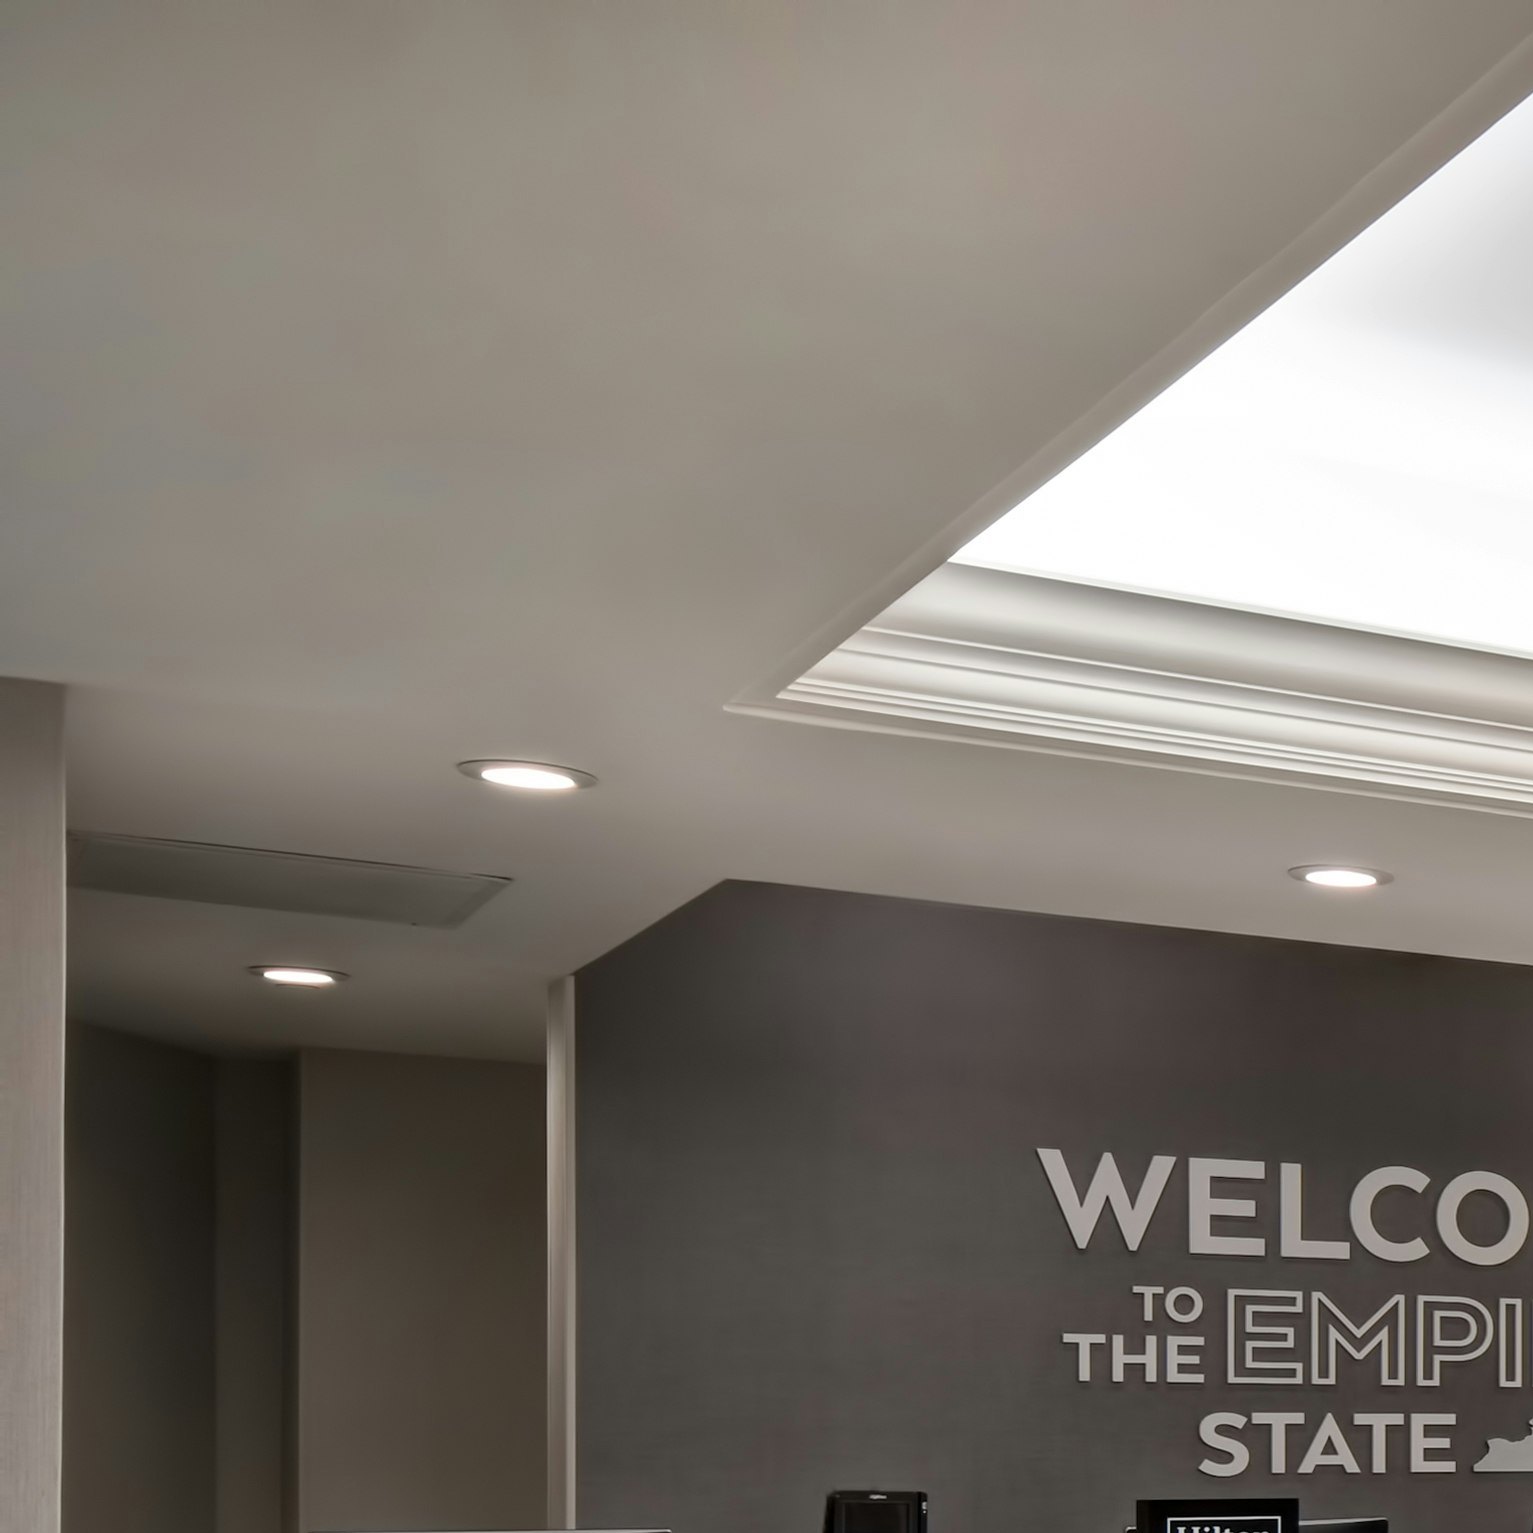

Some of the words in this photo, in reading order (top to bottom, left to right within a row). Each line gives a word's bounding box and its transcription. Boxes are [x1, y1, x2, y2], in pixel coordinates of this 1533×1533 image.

[1132, 1285, 1204, 1323] TO
[1062, 1332, 1205, 1383] THE
[1198, 1411, 1457, 1477] STATE
